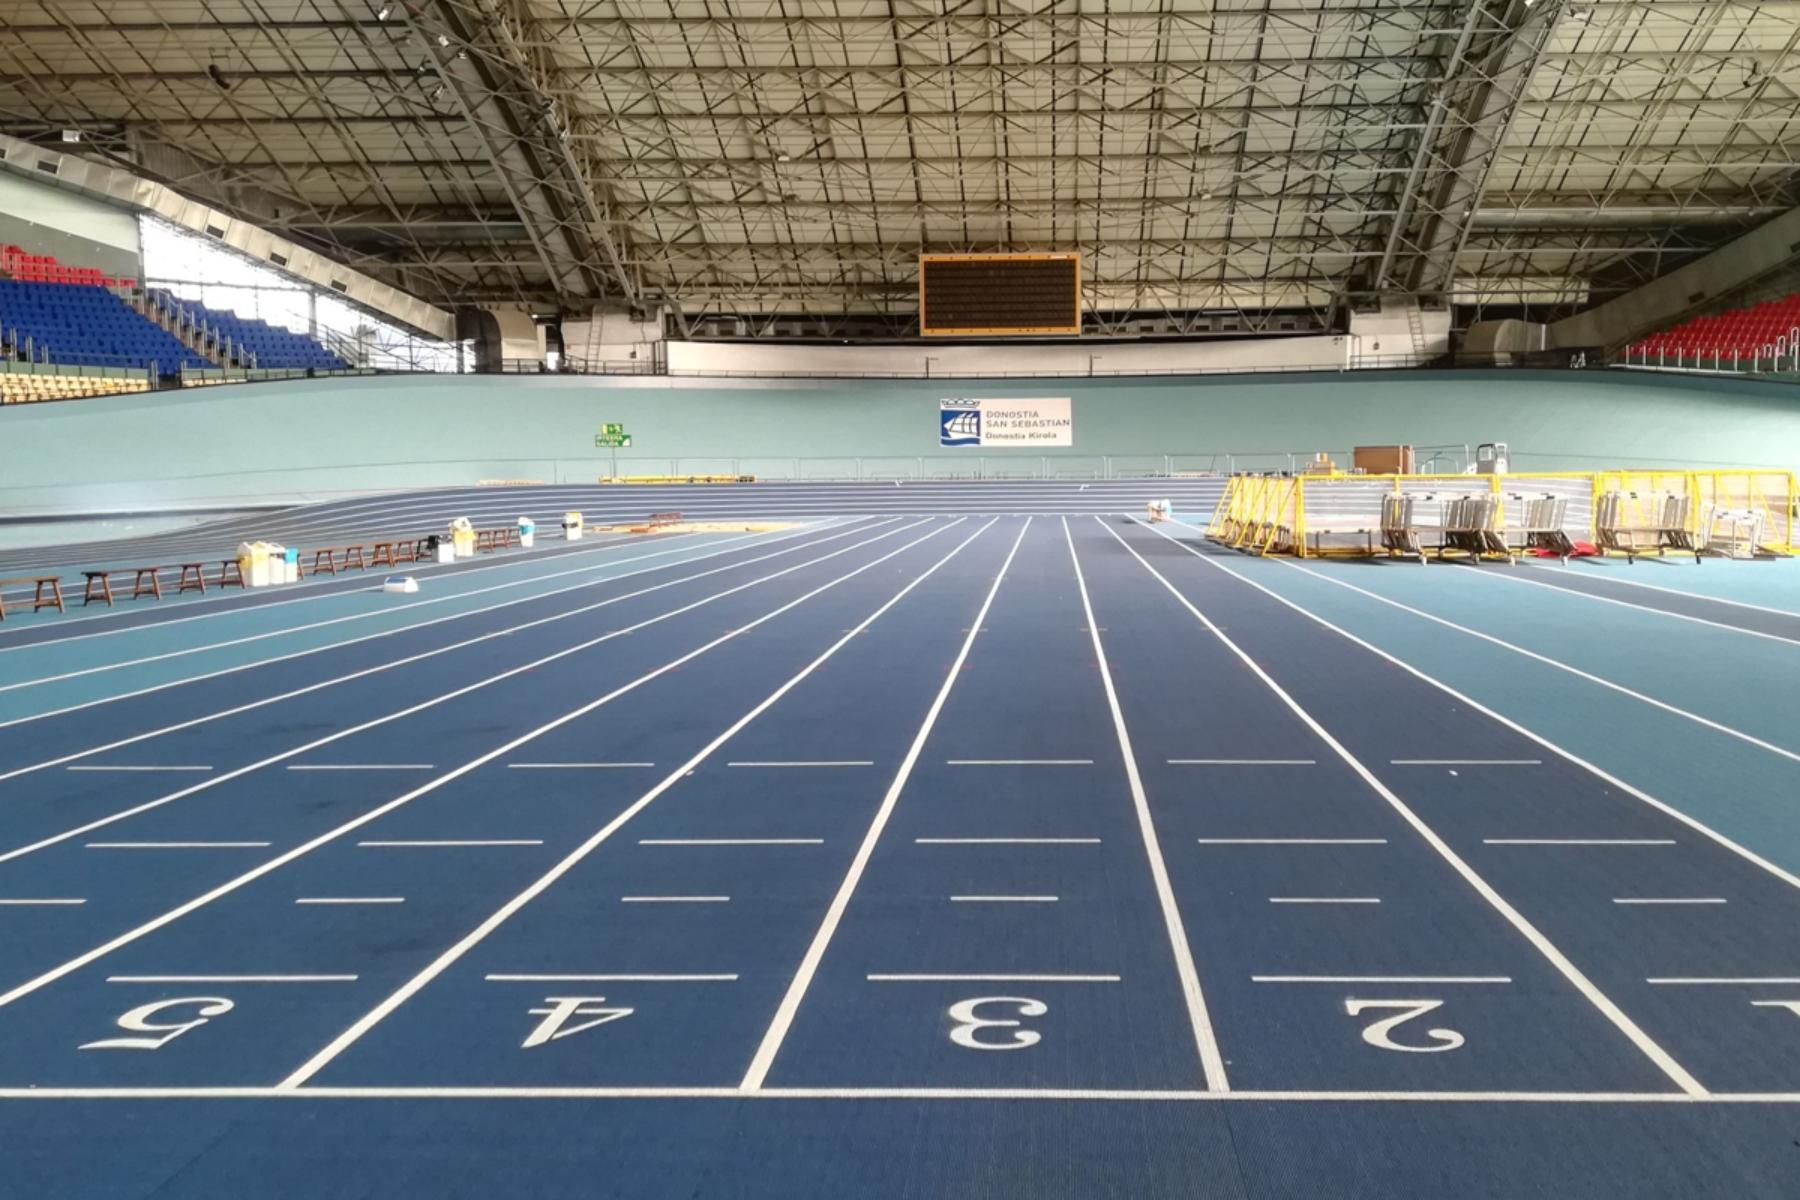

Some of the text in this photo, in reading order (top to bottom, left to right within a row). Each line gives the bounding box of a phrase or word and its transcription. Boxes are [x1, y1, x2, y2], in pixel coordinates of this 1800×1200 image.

[985, 431, 1026, 439] Donostia
[986, 410, 1039, 418] DONOSTIA
[986, 419, 1070, 428] SAN SEBASTIAN
[78, 996, 235, 1050] 5
[521, 996, 635, 1048] 4
[947, 996, 1048, 1050] 3
[1344, 997, 1465, 1053] 2
